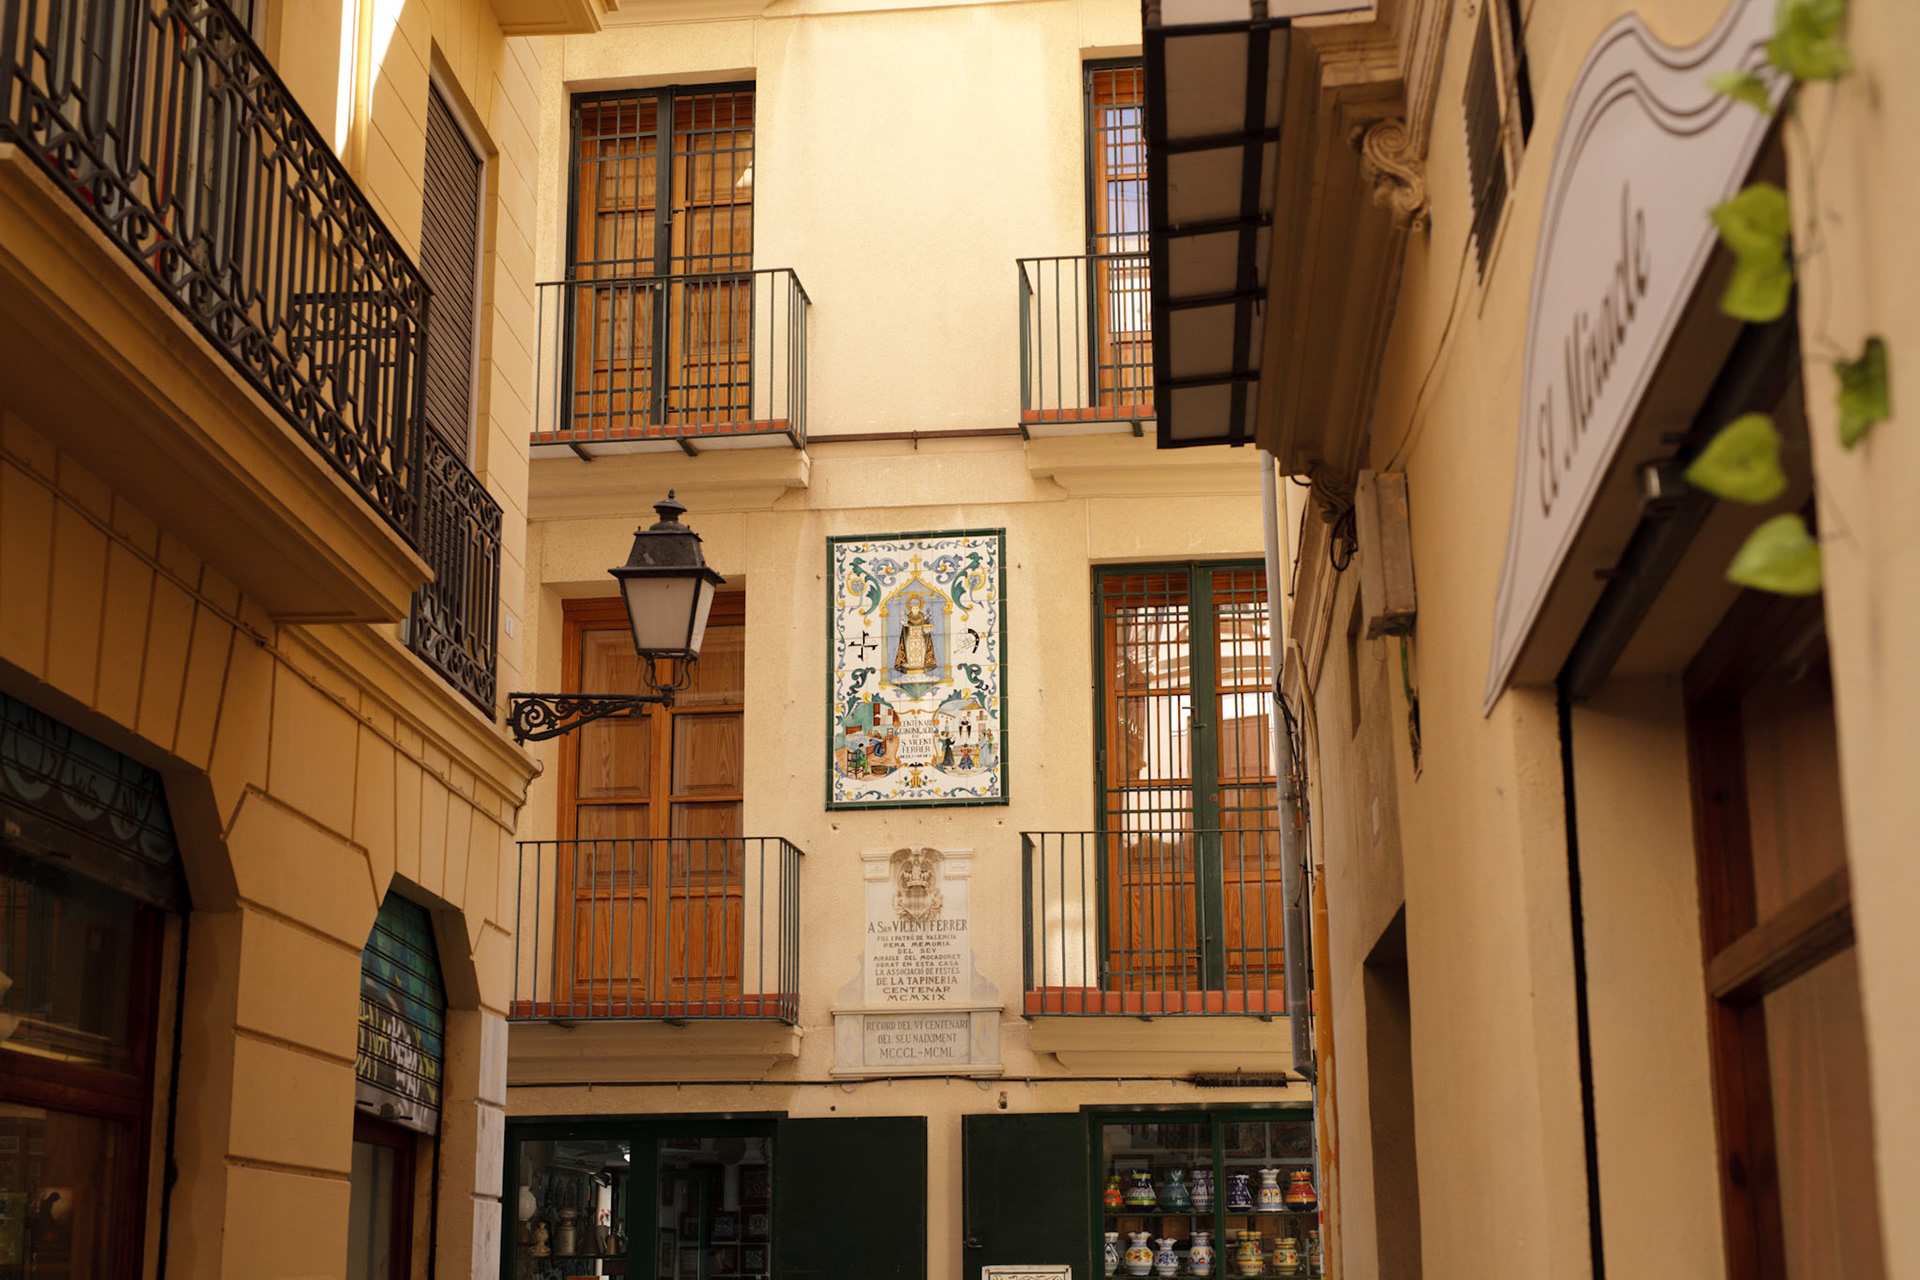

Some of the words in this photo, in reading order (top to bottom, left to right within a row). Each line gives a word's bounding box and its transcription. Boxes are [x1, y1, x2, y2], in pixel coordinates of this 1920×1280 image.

[1537, 382, 1560, 520] El
[1563, 177, 1650, 472] Miracle
[902, 746, 931, 754] FERRER
[868, 921, 875, 934] A
[892, 920, 927, 933] VICENT
[930, 919, 968, 931] FERRER
[925, 967, 934, 975] DE
[935, 967, 961, 975] FESTES
[876, 977, 888, 986] DE
[890, 977, 904, 986] LA
[907, 975, 958, 985] TAPINERIA
[882, 986, 951, 994] CENTENAR
[887, 994, 946, 1002] MCMXIX
[866, 1020, 896, 1031] RECORD
[897, 1020, 912, 1031] DEL
[914, 1020, 923, 1030] VI
[924, 1019, 968, 1030] CENTENARI
[878, 1034, 893, 1045] DEL
[895, 1033, 911, 1044] SEU
[912, 1032, 957, 1043] NAIXIMENT
